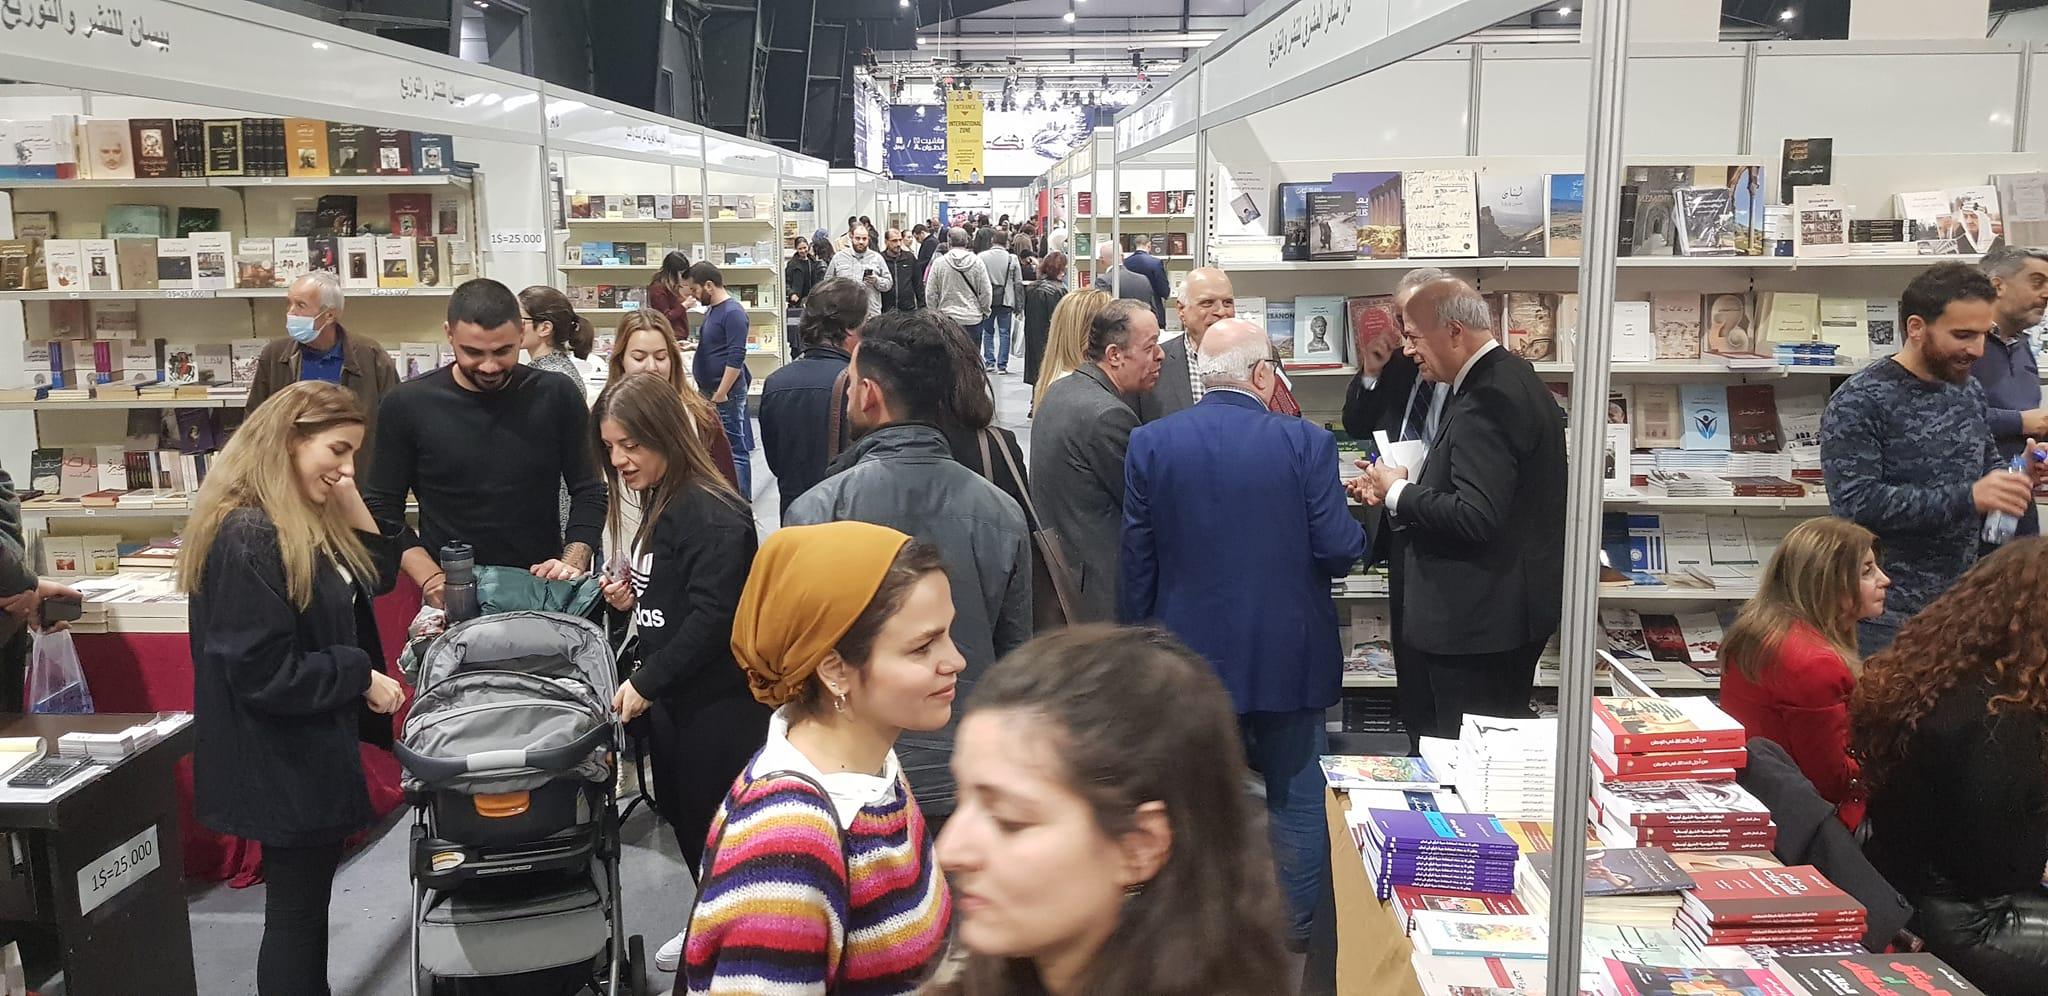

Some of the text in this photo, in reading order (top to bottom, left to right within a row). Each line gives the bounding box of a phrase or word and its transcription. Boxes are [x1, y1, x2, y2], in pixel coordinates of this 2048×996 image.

[84, 5, 124, 38] للنشر
[129, 15, 170, 53] بيسان
[491, 234, 542, 245] 1$=25.000
[91, 840, 152, 892] 1$=25.000
